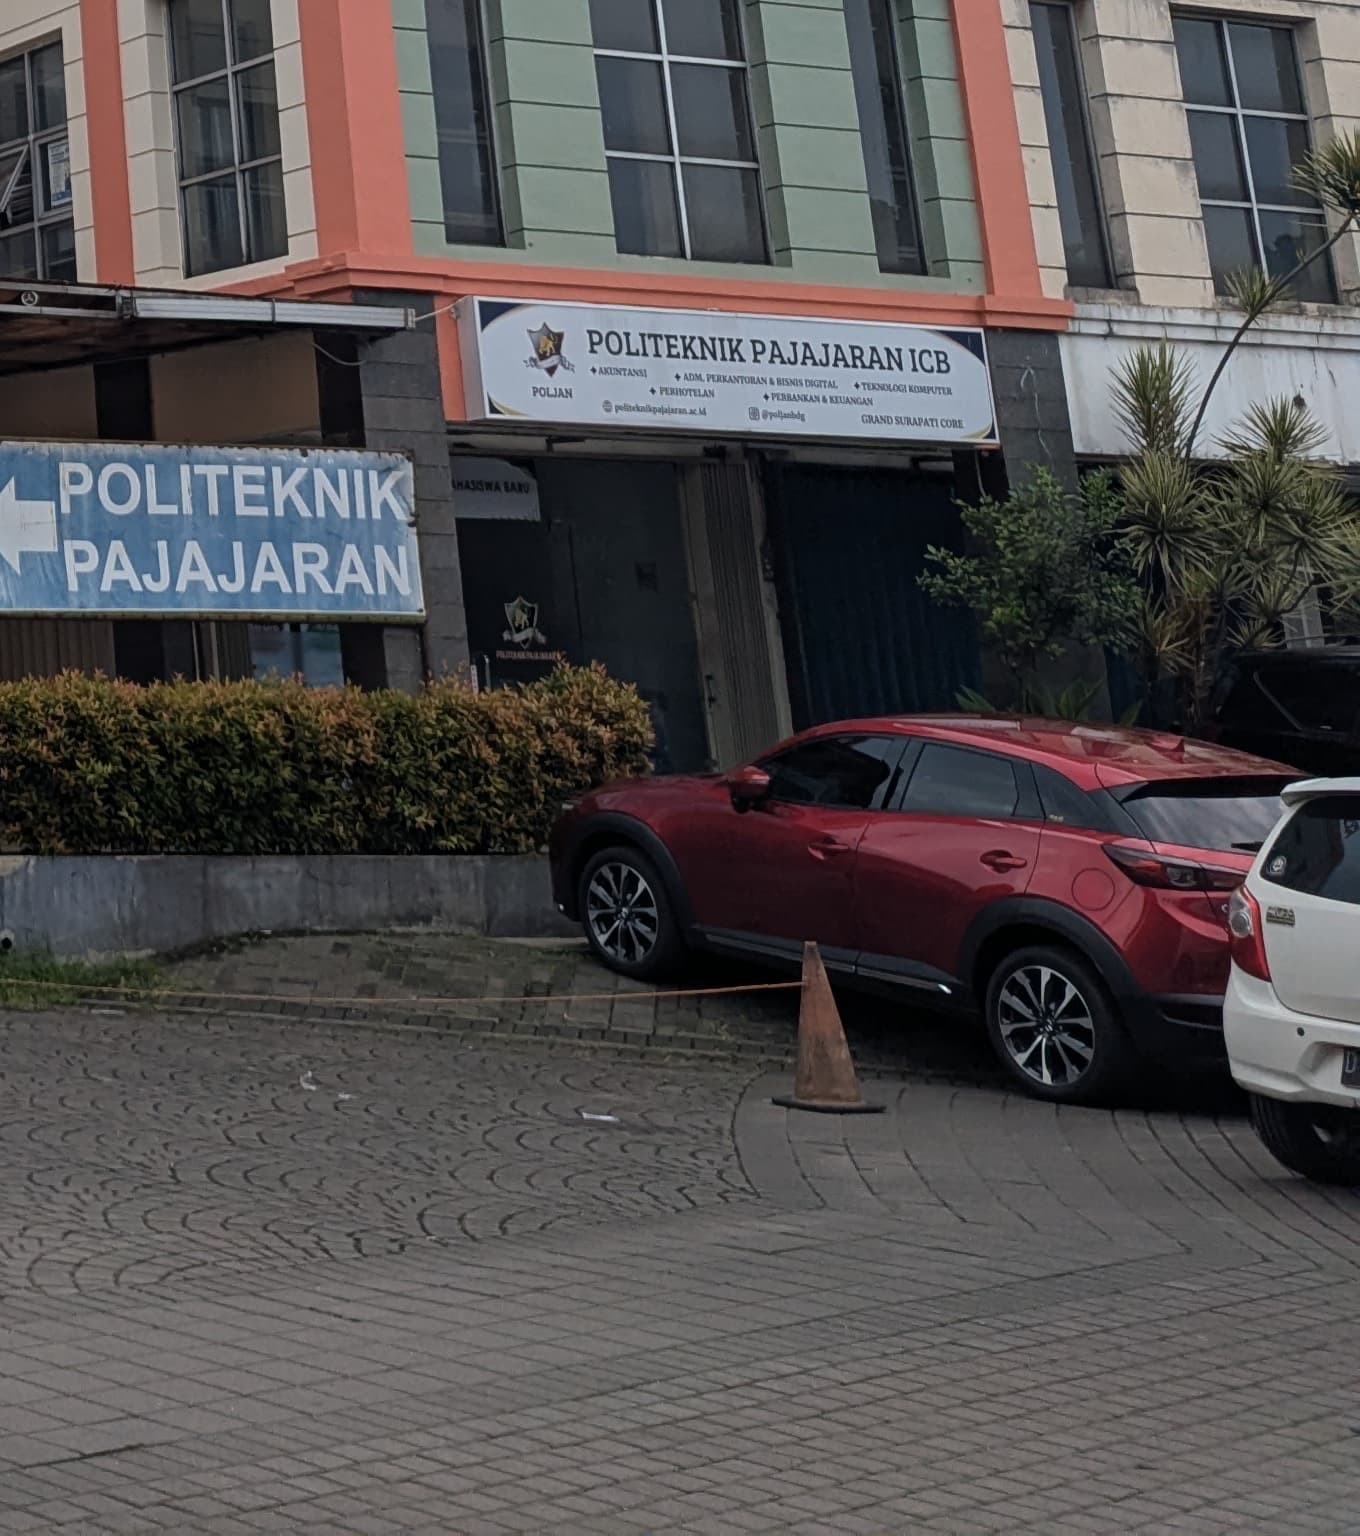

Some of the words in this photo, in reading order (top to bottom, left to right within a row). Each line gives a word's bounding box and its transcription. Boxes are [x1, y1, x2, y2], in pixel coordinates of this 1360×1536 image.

[586, 328, 747, 363] POLITEKNIK
[750, 338, 904, 372] PAJAJARAN
[909, 348, 952, 375] ICB
[598, 366, 648, 378] AKUNTANSI
[706, 374, 768, 385] PERKANTORAN
[769, 377, 775, 386] &
[776, 378, 803, 387] BISNIS
[805, 379, 839, 390] DIGITAL
[861, 382, 907, 393] TEKNOLOGI
[908, 384, 953, 396] KOMPUTER
[531, 386, 573, 399] POLJAN
[659, 386, 715, 398] PERHOTELAN
[771, 392, 820, 403] PERBANKAN
[829, 395, 874, 406] KEUANGAN
[861, 414, 894, 425] GRAND
[894, 415, 939, 428] SURAPATI
[940, 418, 964, 429] CORE
[58, 461, 408, 521] POLITEKNIK
[63, 539, 412, 596] PAJAJARAN
